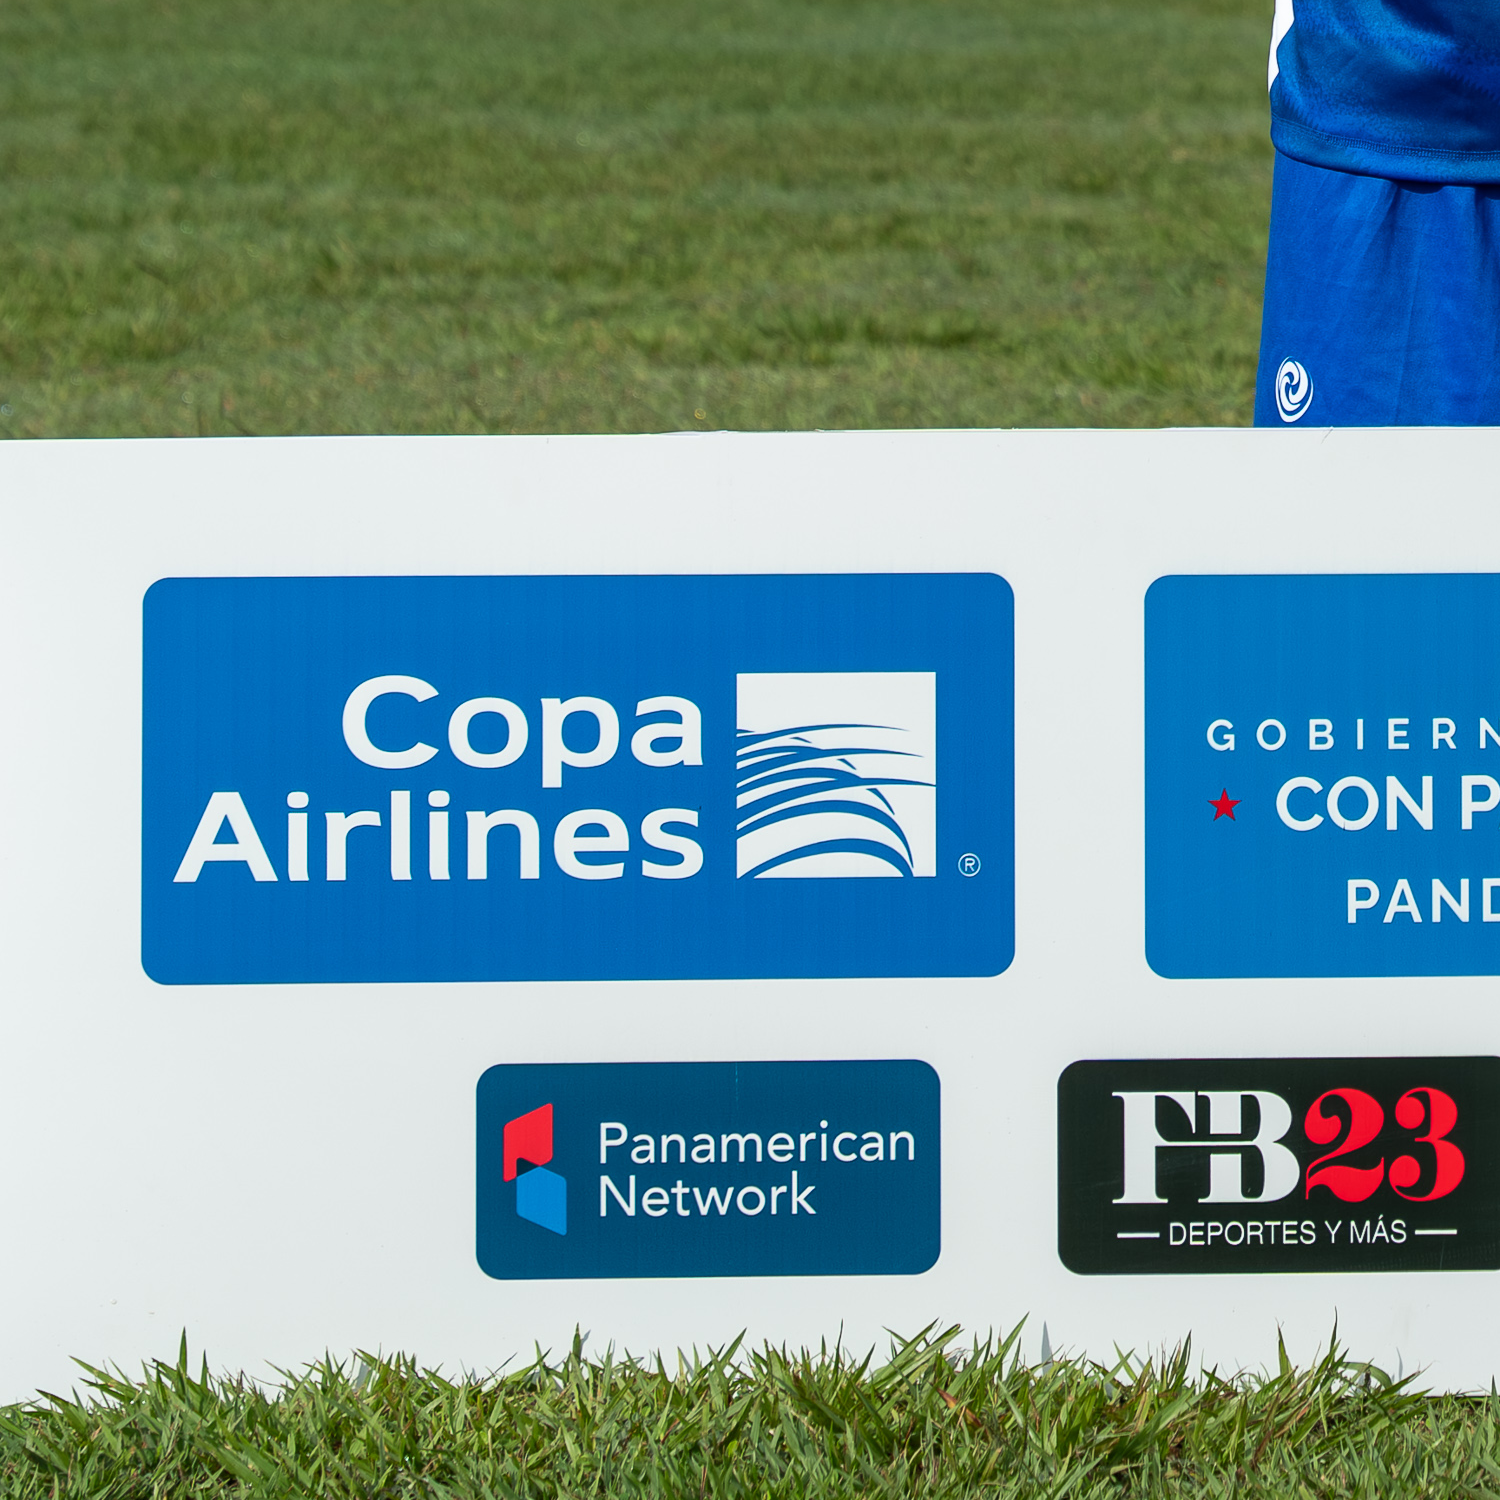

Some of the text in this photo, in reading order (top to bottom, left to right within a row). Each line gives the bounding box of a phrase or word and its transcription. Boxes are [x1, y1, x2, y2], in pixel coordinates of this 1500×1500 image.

[342, 674, 704, 788] Copa
[1275, 775, 1433, 832] CON
[173, 790, 705, 883] Airlines
[599, 1119, 916, 1165] Panamerican
[599, 1170, 817, 1217] Network
[1168, 1214, 1408, 1246] DEPORTES Y MÁS
